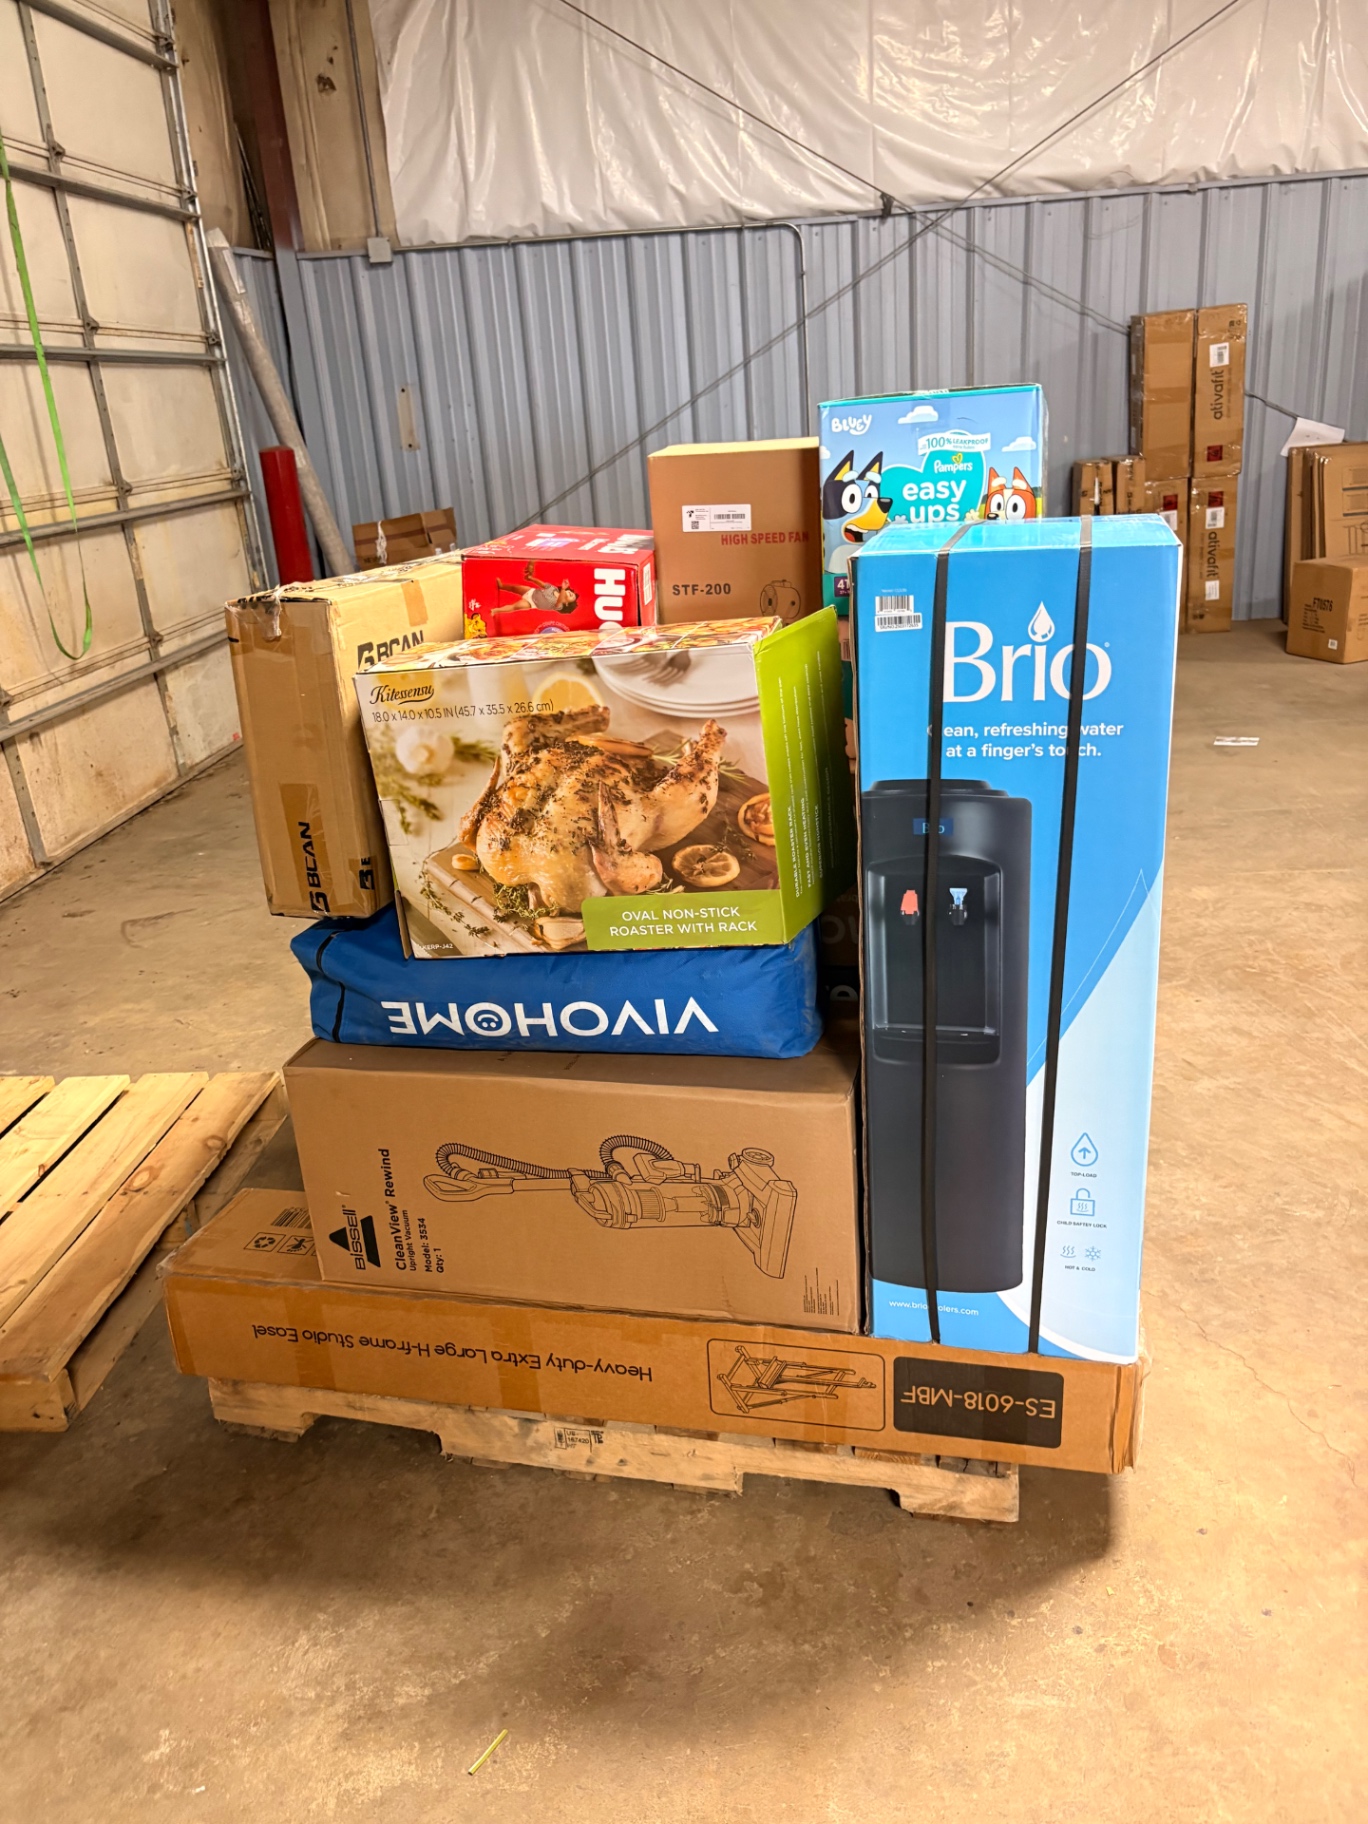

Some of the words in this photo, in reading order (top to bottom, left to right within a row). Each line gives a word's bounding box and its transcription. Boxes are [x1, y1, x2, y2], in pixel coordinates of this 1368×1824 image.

[831, 414, 872, 436] BLUEY
[925, 437, 952, 449] 100%
[952, 438, 989, 446] LEAKPROOF
[934, 460, 973, 474] Pampers
[902, 480, 967, 503] easy
[910, 503, 960, 523] ups
[721, 534, 748, 546] HIGH
[750, 532, 786, 545] SPEED
[788, 531, 810, 543] FAN
[672, 583, 731, 596] STF-200
[369, 684, 435, 706] Kitessensu
[372, 711, 390, 723] 18.0
[392, 713, 398, 721] x
[399, 709, 416, 721] 14.0
[424, 708, 442, 720] 10.5
[486, 703, 506, 716] 35.5
[514, 702, 534, 714] 26.6
[536, 699, 554, 713] cm)
[926, 724, 979, 739] ean,
[984, 721, 1069, 739] refreshing
[946, 744, 962, 758] at
[966, 746, 977, 758] a
[1048, 743, 1102, 758] toch.
[621, 910, 659, 922] OVAL
[662, 906, 741, 920] NON-STICK
[609, 924, 674, 937] ROASTER
[677, 922, 715, 934] WITH
[718, 921, 758, 933] RACK
[380, 996, 720, 1037] VIVOHOME
[378, 1148, 396, 1198] Rewind
[402, 1210, 412, 1241] Vacuum
[417, 1218, 429, 1241] 3534
[406, 1242, 417, 1271] Upright
[421, 1243, 433, 1273] Model:
[436, 1255, 445, 1274] Qty:
[889, 1300, 979, 1316] www.brioolers.com
[251, 1324, 299, 1343] Easel
[302, 1330, 355, 1349] Studio
[359, 1336, 431, 1357] H-frame
[434, 1341, 488, 1364] Large
[491, 1350, 541, 1370] Extra
[546, 1352, 653, 1382] Heavy-duty
[901, 1384, 1057, 1419] ES-6018-MBF
